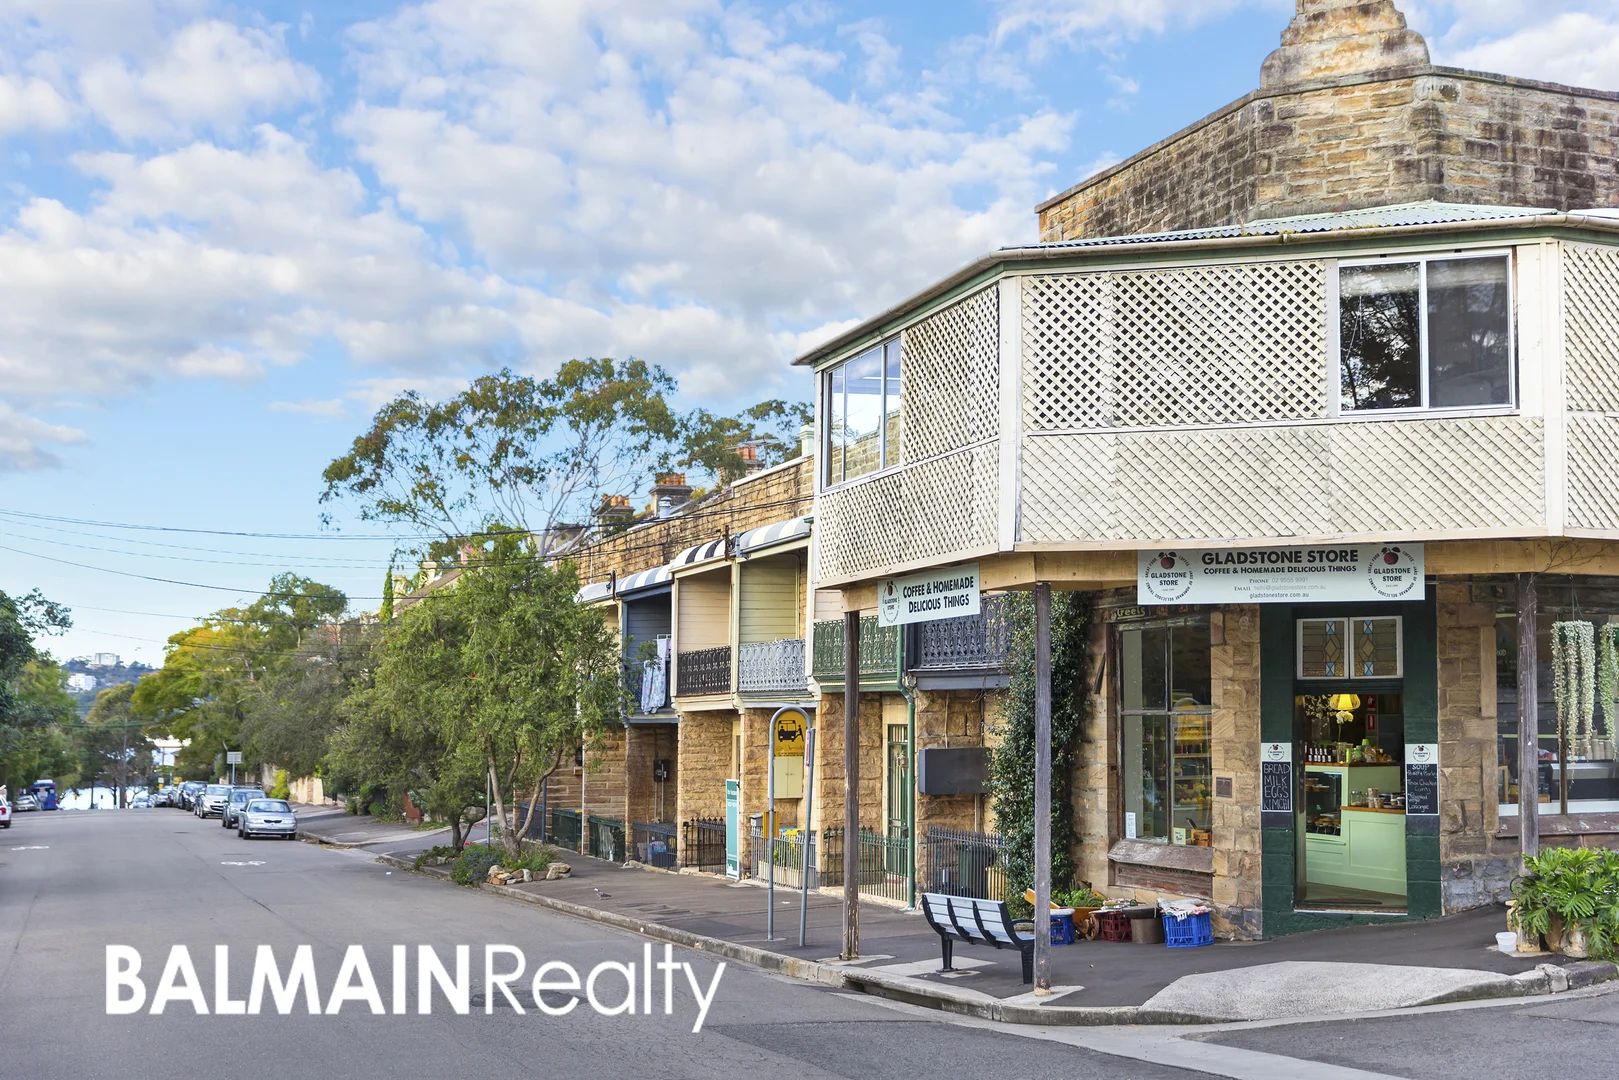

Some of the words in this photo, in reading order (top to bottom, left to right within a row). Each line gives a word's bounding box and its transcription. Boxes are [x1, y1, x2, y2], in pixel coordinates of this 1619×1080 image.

[1202, 550, 1302, 565] GLADSTONE
[1307, 550, 1358, 563] STORE
[903, 585, 925, 598] COFFEE
[926, 582, 931, 594] &
[933, 576, 974, 593] HOMEMADE
[909, 598, 941, 613] DELICIOUS
[944, 594, 969, 608] THINGS
[1264, 764, 1290, 774] BREAD
[1265, 776, 1286, 786] MILK
[1265, 786, 1289, 798] EGGS
[1264, 799, 1290, 810] KIMCHI
